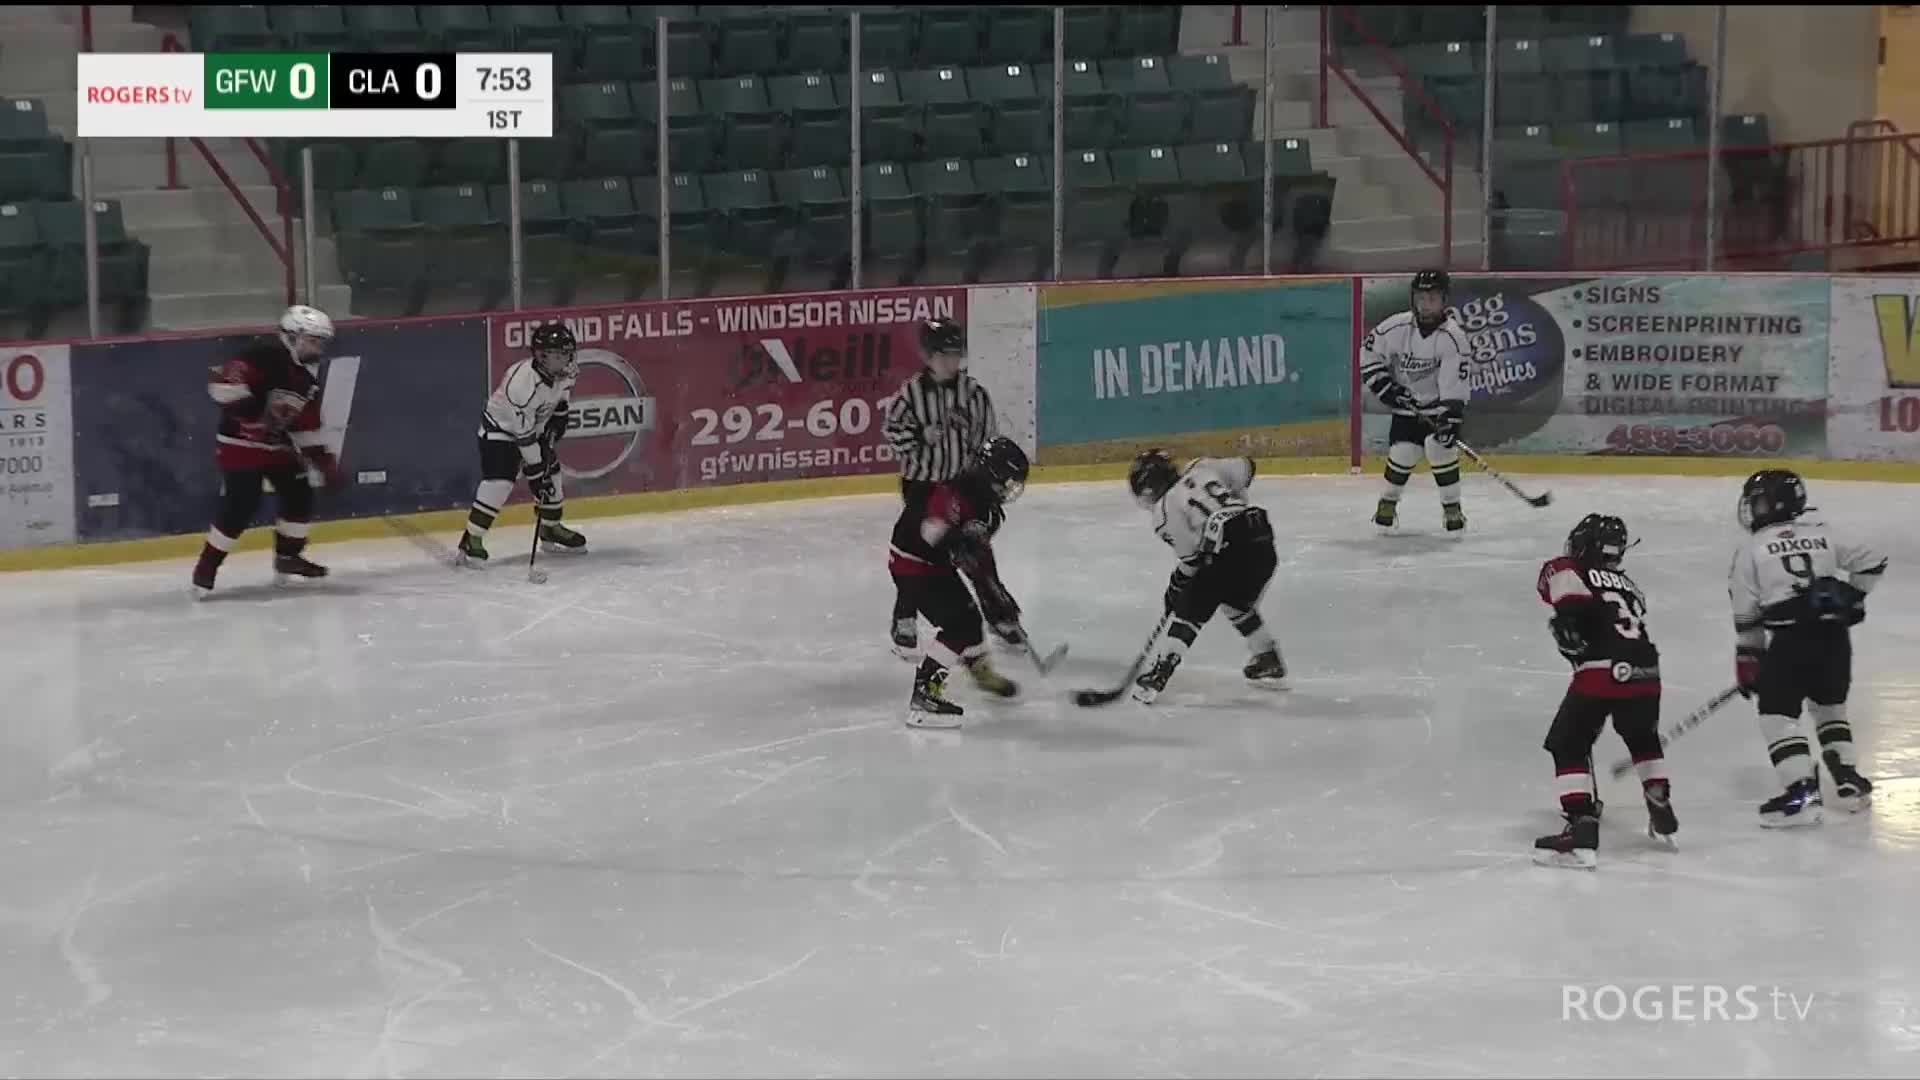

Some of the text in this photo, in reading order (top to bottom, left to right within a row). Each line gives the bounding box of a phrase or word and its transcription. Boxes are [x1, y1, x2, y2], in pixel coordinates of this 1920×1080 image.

[1586, 286, 1661, 304] SIGNS
[505, 316, 602, 348] GRND
[608, 309, 694, 341] FALLS
[716, 299, 843, 333] WINDSOR
[849, 295, 954, 325] NISSAN
[1586, 314, 1803, 335] SCREENPRINTING
[1584, 344, 1744, 363] EMBROIDERY
[1093, 333, 1300, 400] IN DEMAND.
[1586, 373, 1780, 393] & WIDE FORMAT
[566, 404, 644, 430] SSAN
[701, 444, 899, 481] gfwnissan.co
[1767, 537, 1828, 555] DIXON
[1780, 552, 1816, 588] 9
